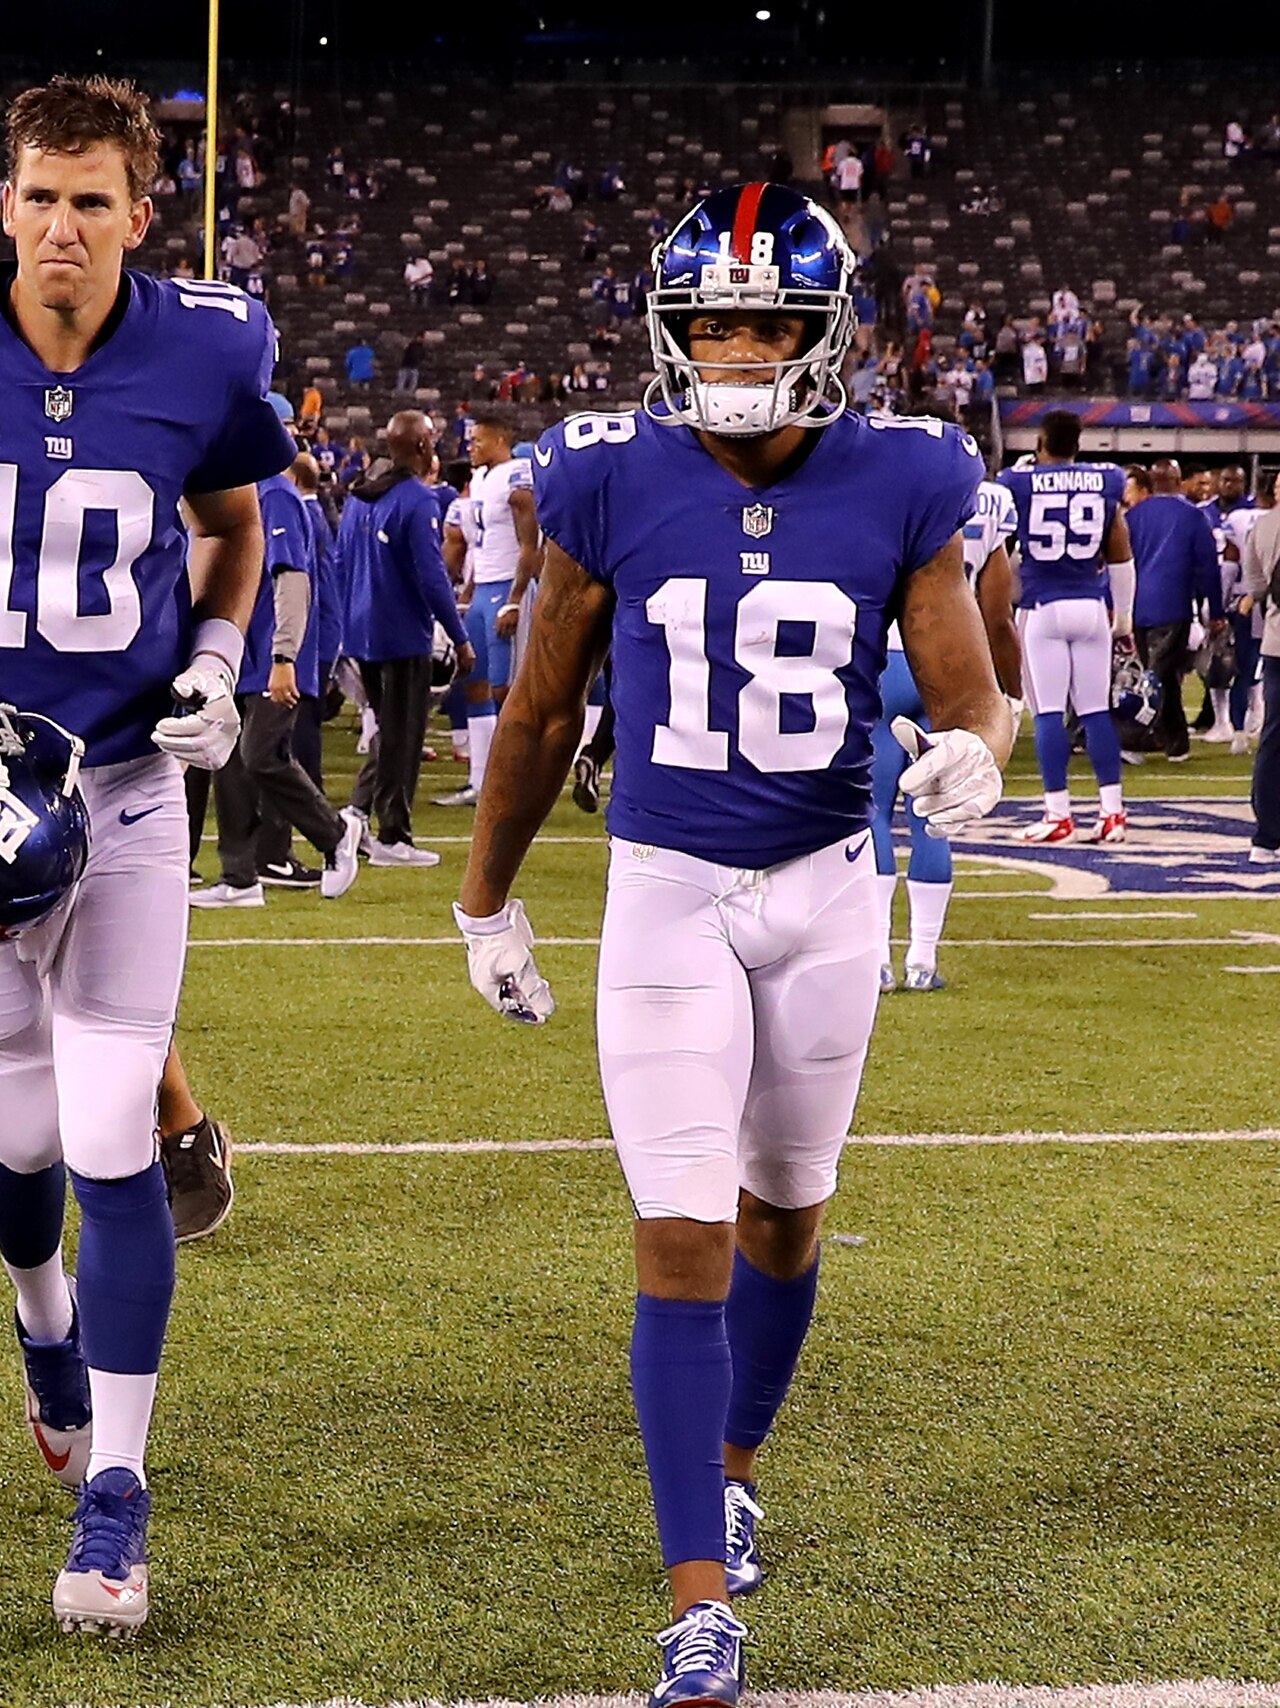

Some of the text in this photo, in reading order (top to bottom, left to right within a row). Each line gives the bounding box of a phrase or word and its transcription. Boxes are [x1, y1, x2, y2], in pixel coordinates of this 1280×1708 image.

[718, 231, 774, 265] 18
[1031, 471, 1103, 492] KENNARD
[1028, 493, 1105, 561] 59
[646, 578, 856, 773] 18
